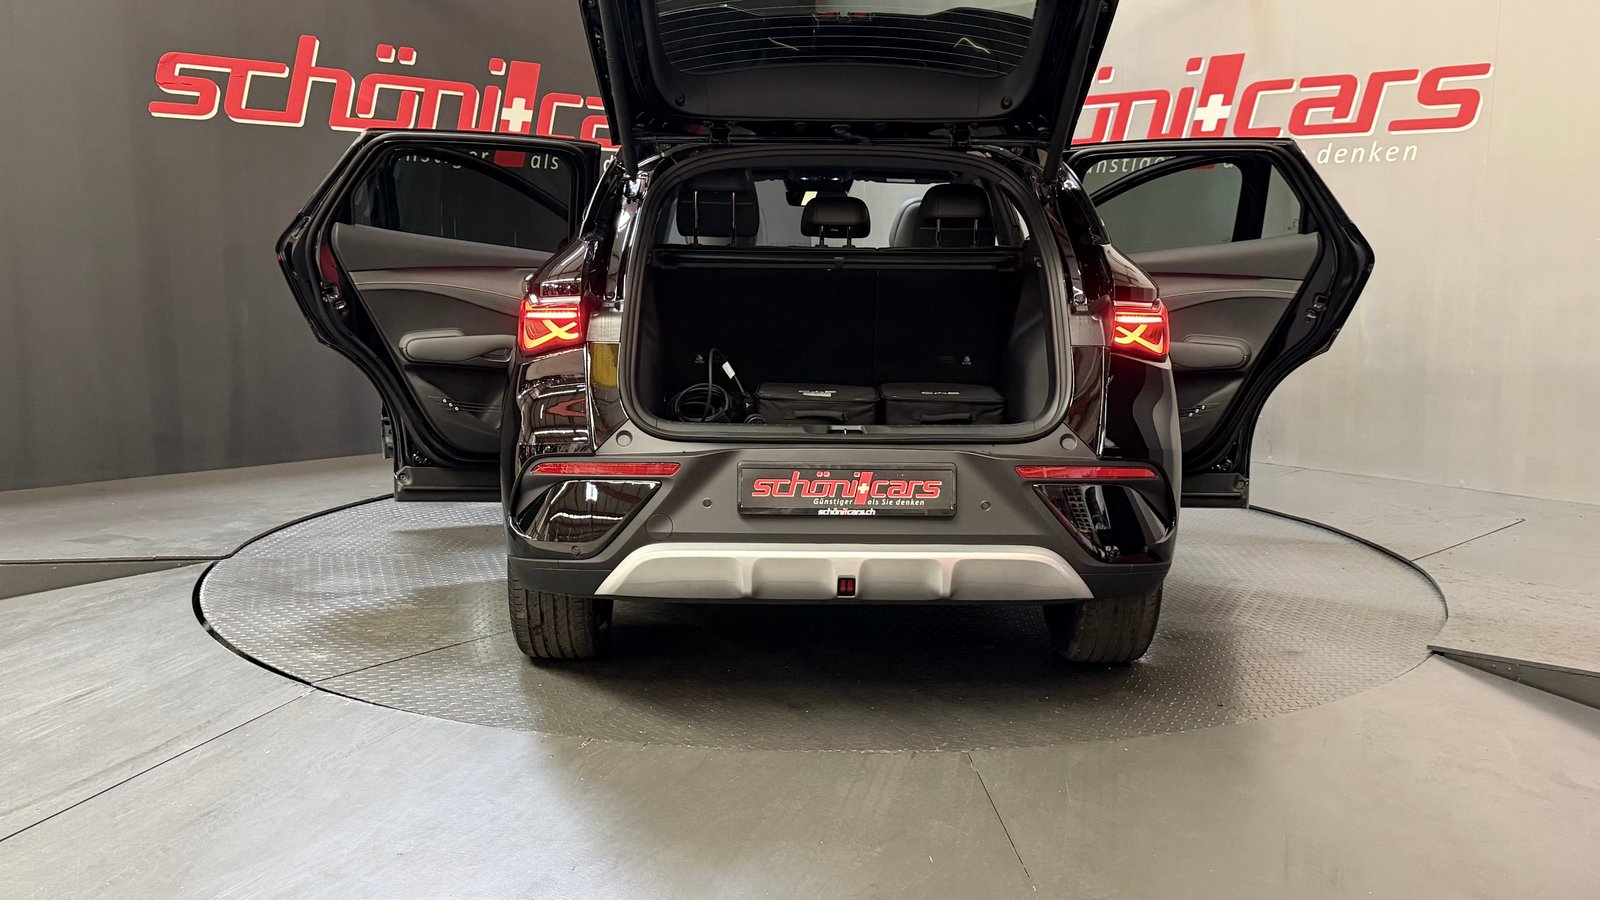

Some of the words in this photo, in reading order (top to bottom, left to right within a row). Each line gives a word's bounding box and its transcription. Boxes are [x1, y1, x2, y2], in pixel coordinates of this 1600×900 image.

[531, 153, 560, 170] als
[1316, 141, 1418, 165] denken
[813, 498, 853, 507] Günstiger
[895, 498, 925, 506] denken
